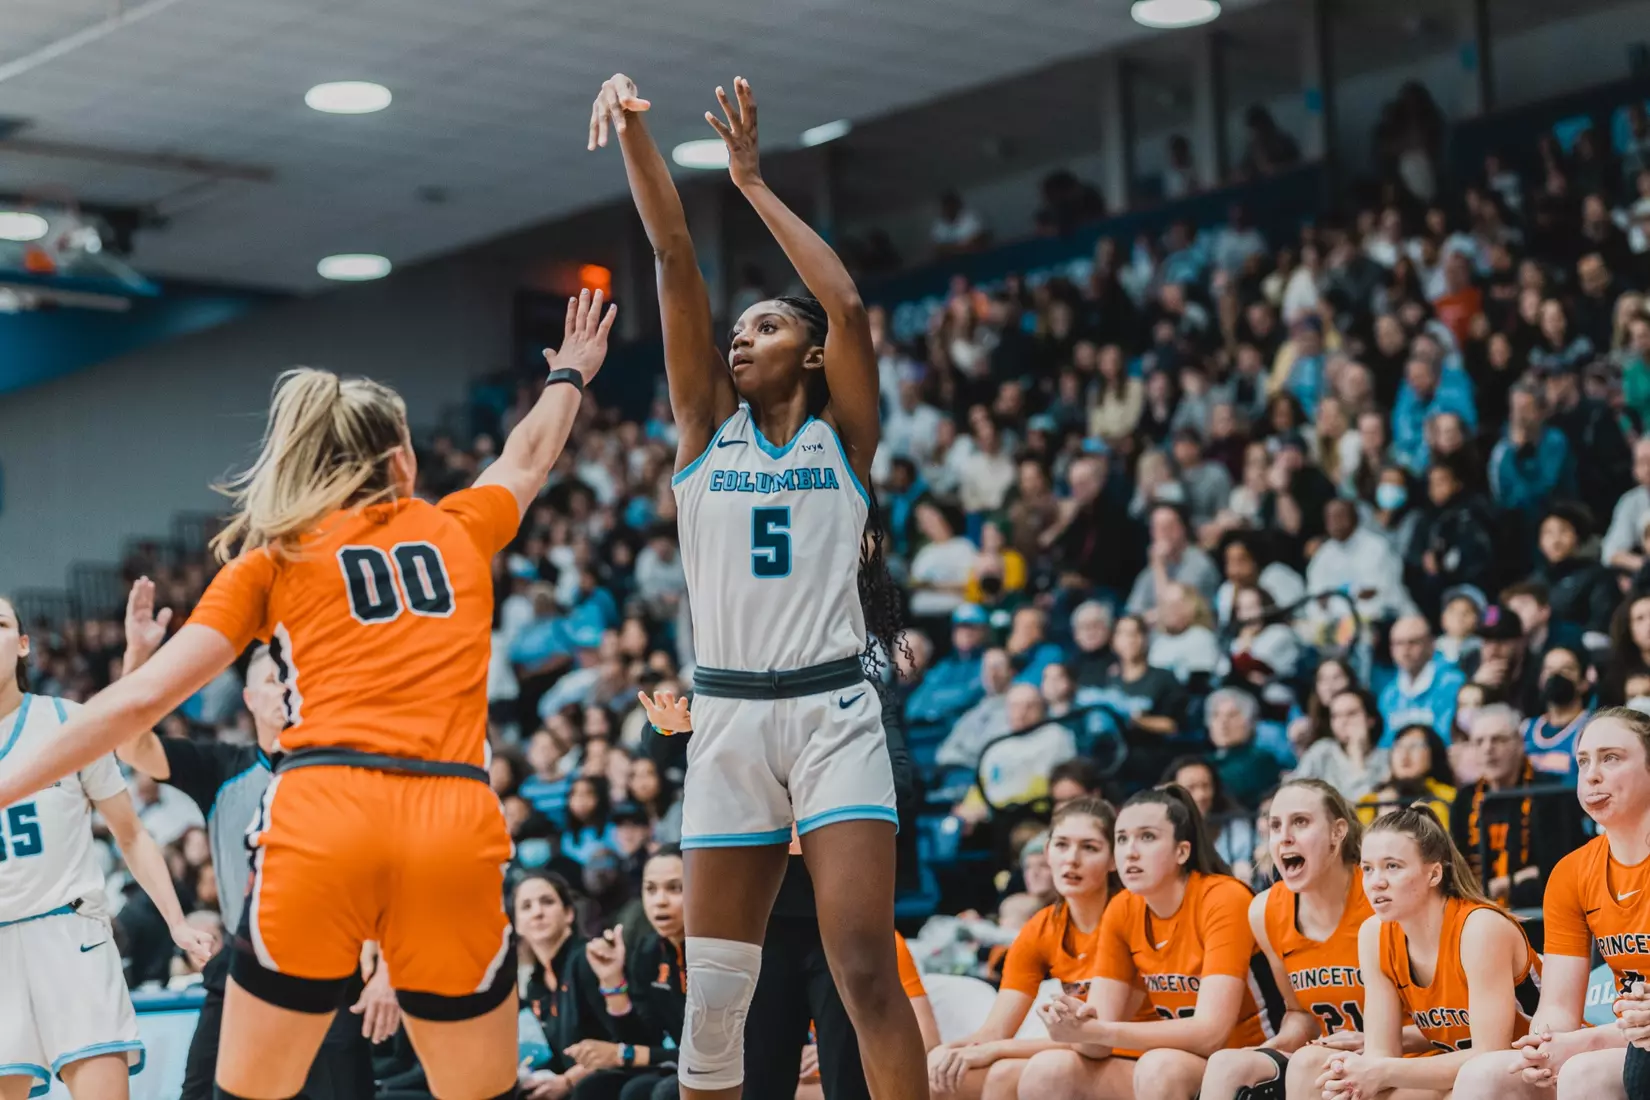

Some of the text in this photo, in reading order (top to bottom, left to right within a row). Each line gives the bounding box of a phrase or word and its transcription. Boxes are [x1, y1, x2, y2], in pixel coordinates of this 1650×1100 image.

[709, 467, 840, 494] COLUMBIA
[751, 505, 792, 579] 5
[336, 540, 456, 626] 00
[0, 800, 44, 864] 5
